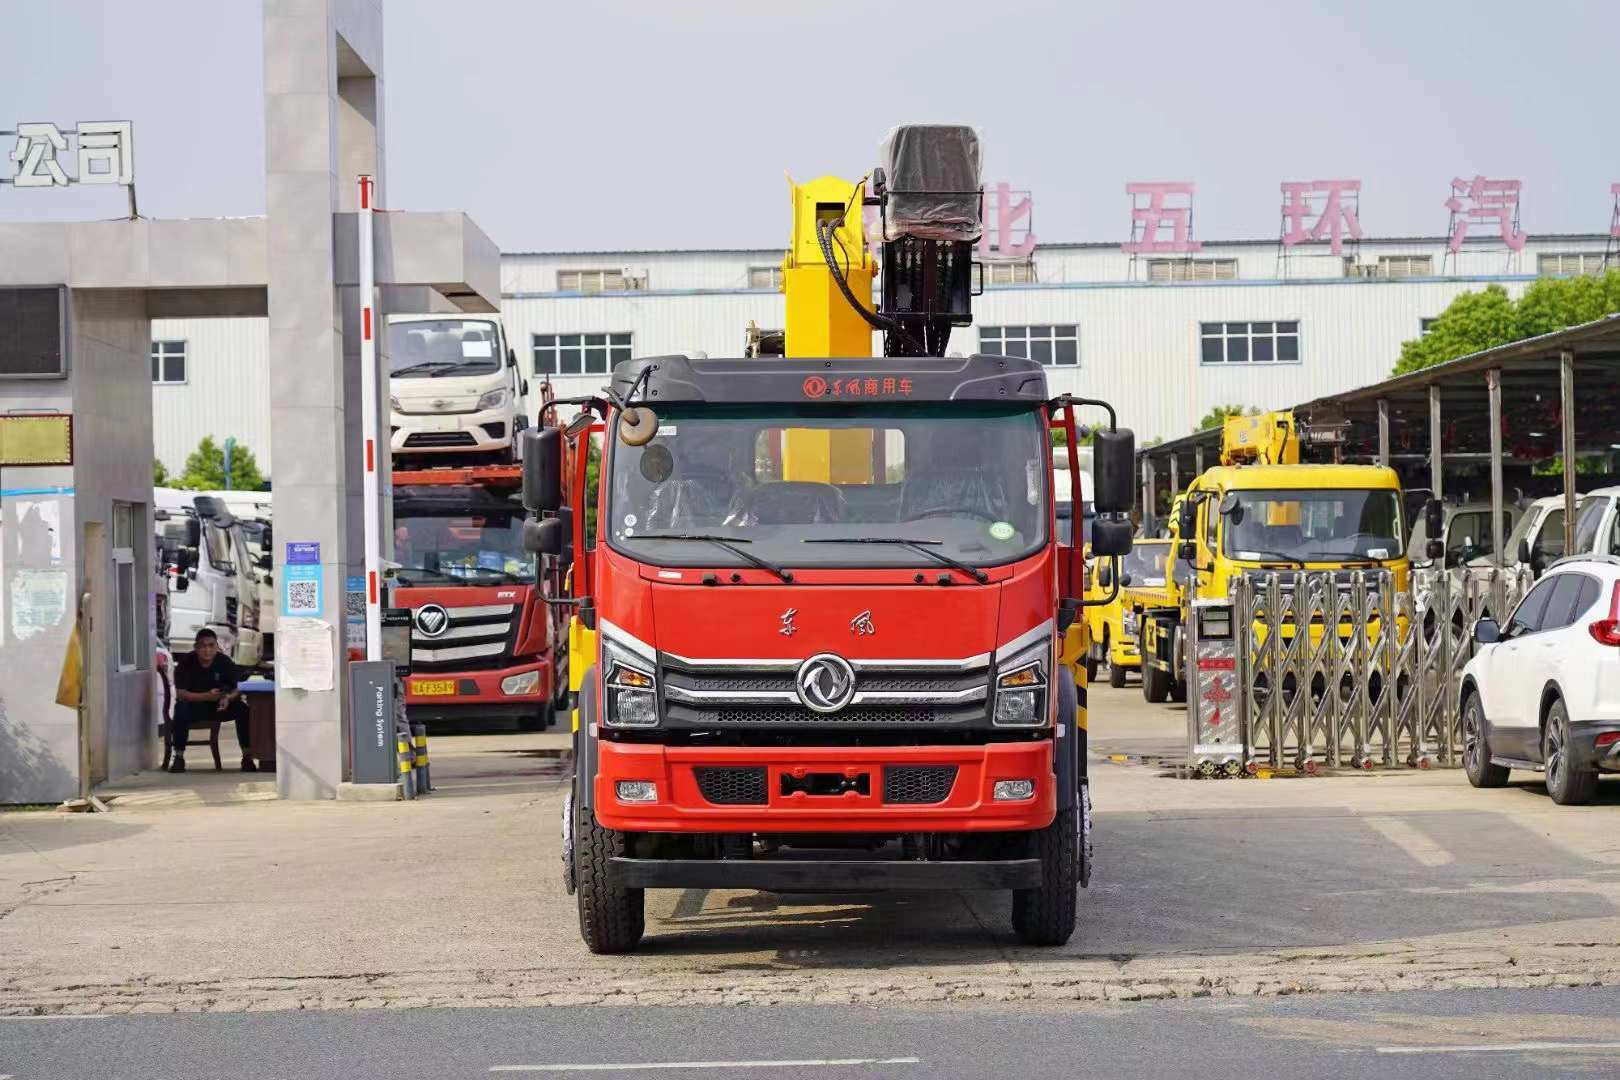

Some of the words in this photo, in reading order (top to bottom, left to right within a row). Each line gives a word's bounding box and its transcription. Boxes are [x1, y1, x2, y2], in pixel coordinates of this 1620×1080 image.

[12, 120, 133, 187] 公司
[376, 687, 384, 717] Parking
[376, 719, 385, 747] System
